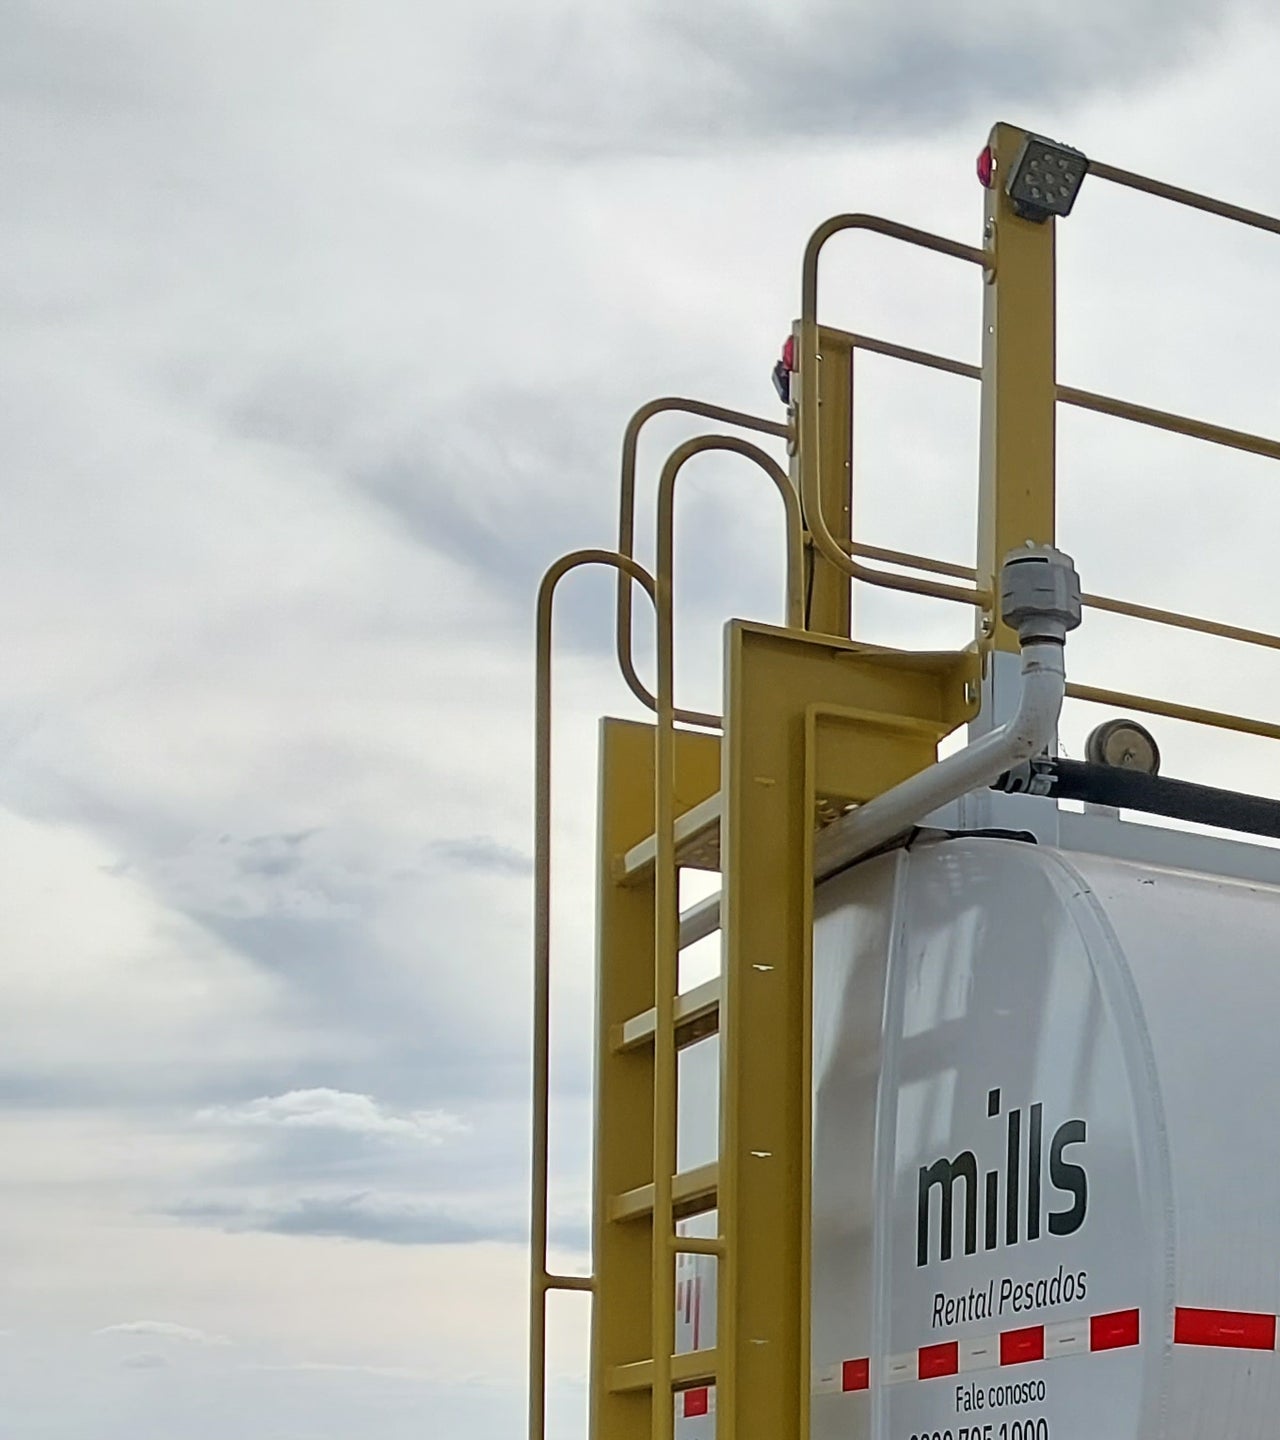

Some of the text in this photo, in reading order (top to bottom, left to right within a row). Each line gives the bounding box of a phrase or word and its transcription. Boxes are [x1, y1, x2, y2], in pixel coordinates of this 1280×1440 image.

[917, 1088, 1087, 1267] mills
[932, 1265, 1087, 1328] Rental Pesados
[956, 1380, 1046, 1412] Fale conosco
